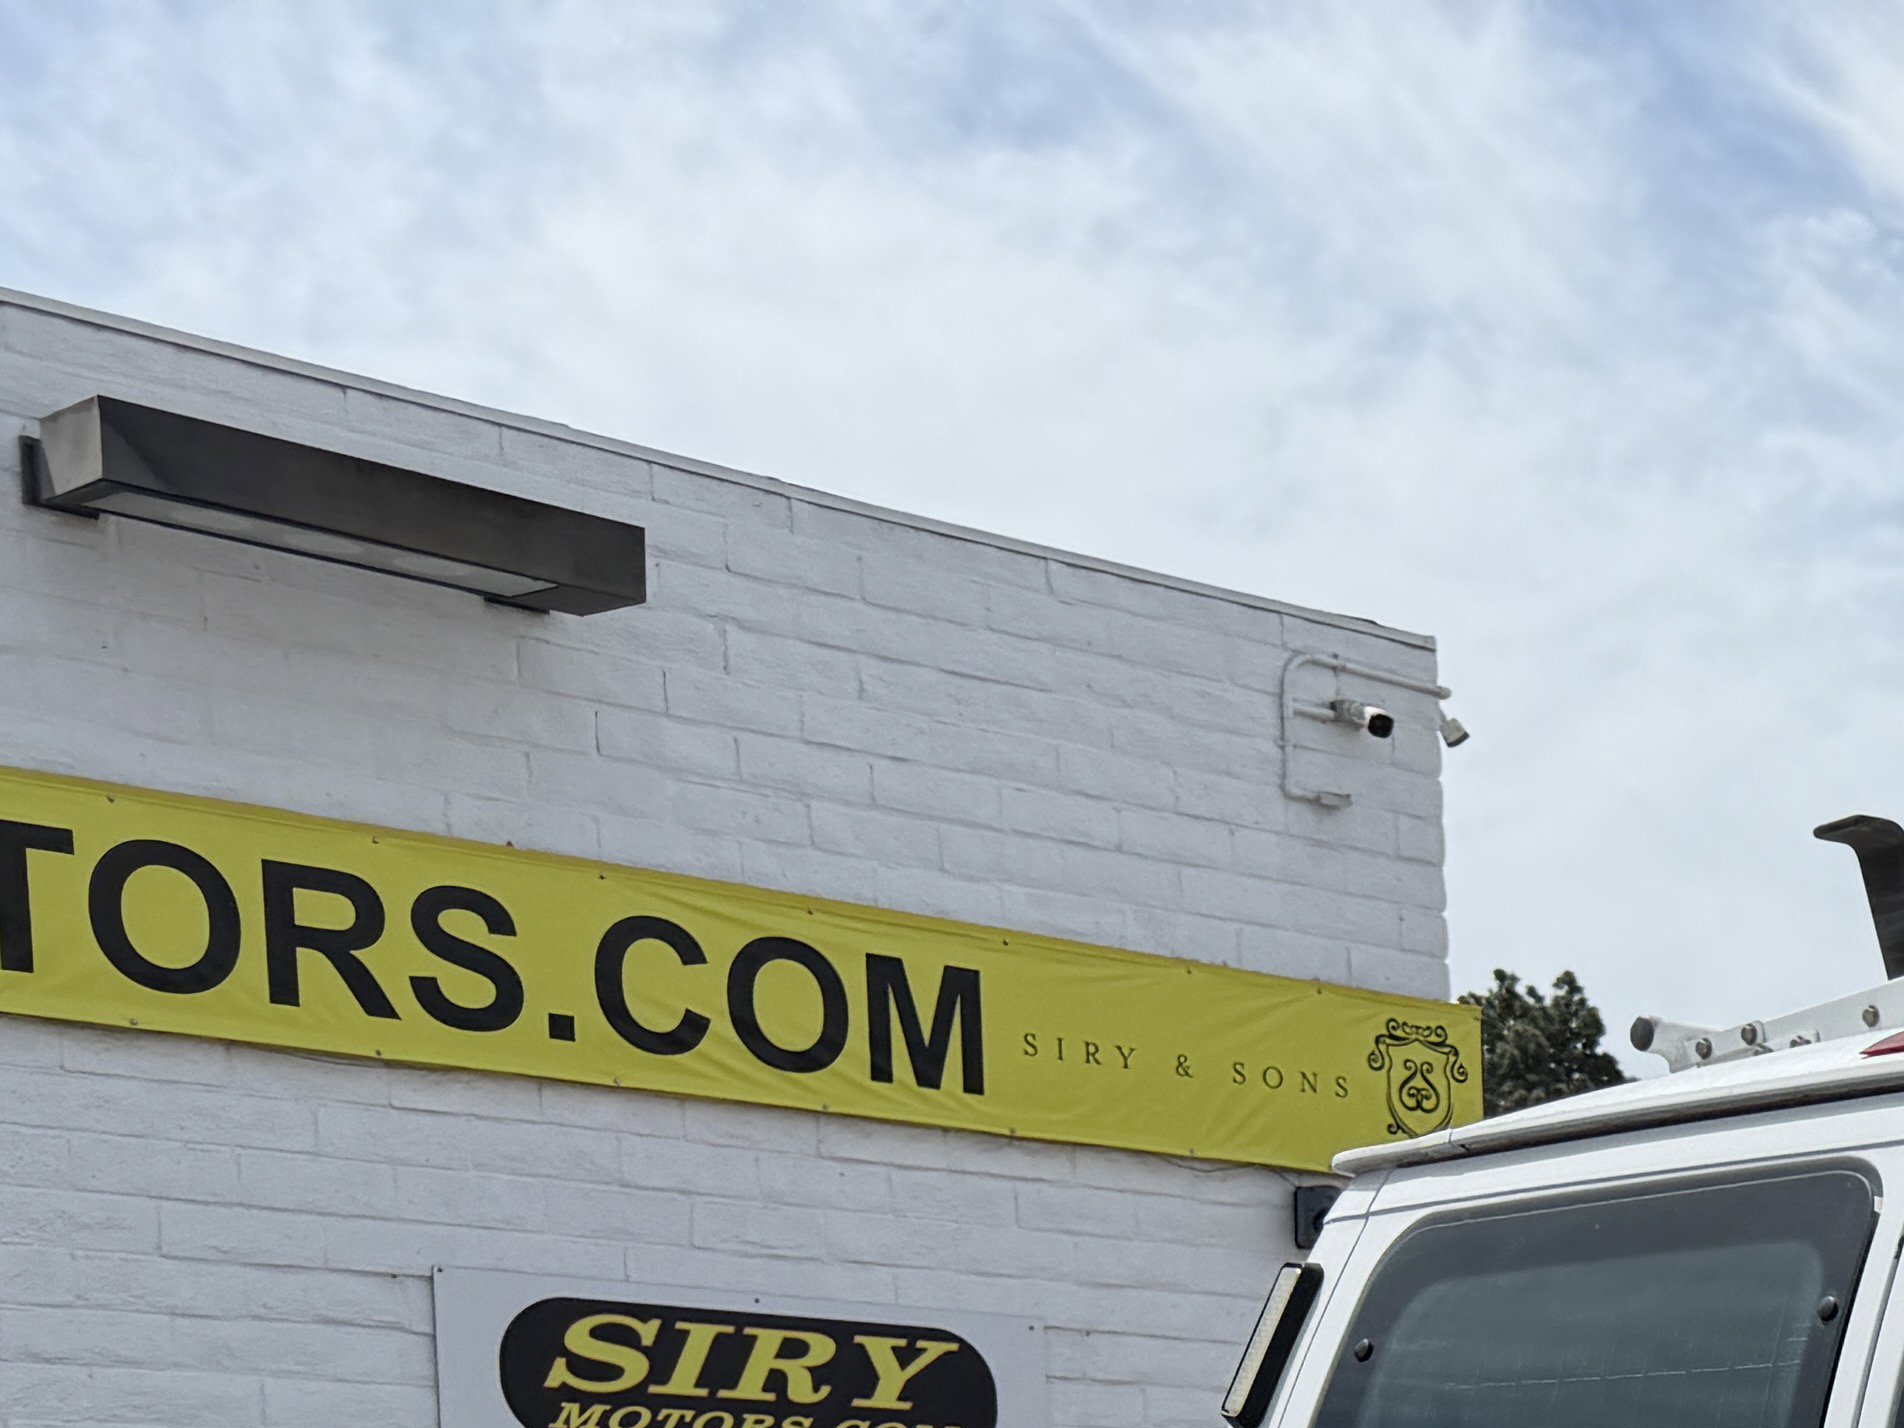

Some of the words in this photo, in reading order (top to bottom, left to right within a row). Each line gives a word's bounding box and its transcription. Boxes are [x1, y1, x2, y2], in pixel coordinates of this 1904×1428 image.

[1023, 1032, 1137, 1070] SIRY
[1175, 1053, 1195, 1079] &
[1232, 1061, 1350, 1099] SONS
[542, 1313, 961, 1411] SIRY
